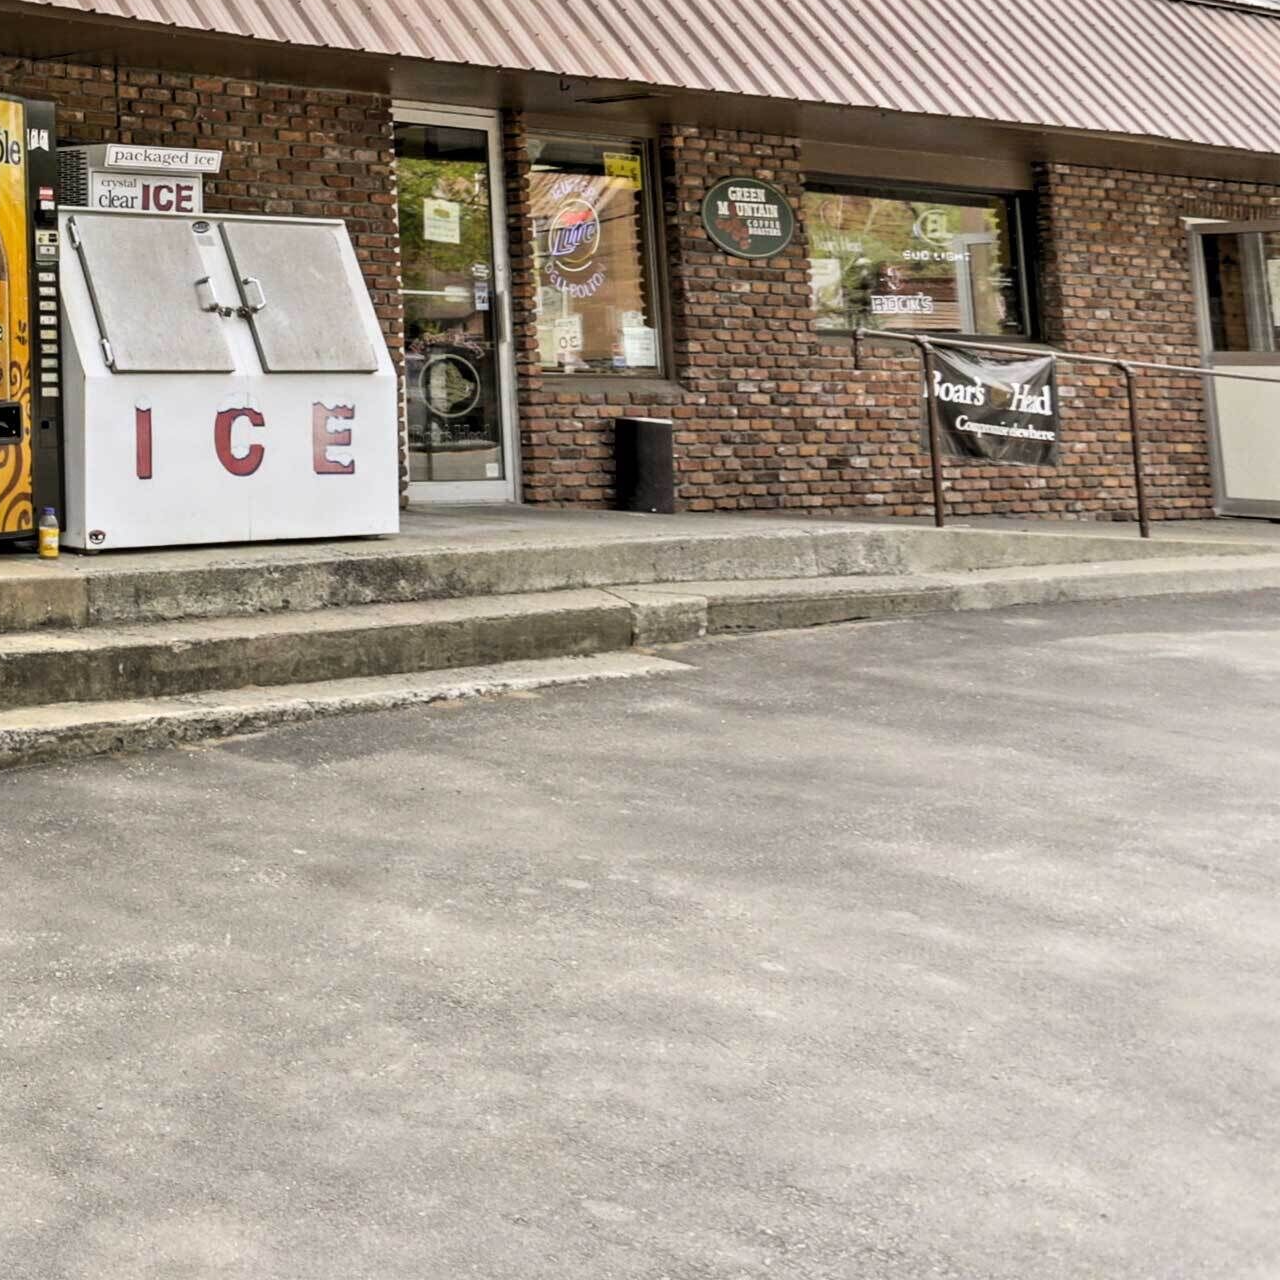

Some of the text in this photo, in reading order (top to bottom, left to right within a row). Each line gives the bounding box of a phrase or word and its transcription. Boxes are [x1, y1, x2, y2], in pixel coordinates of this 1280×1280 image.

[114, 149, 215, 166] packaged ice
[101, 178, 137, 188] crystal
[99, 183, 193, 213] clear ICE
[728, 187, 766, 202] GREEN
[747, 220, 780, 228] COFFEE
[903, 250, 970, 262] BUD LIGHT
[135, 394, 355, 480] ICE
